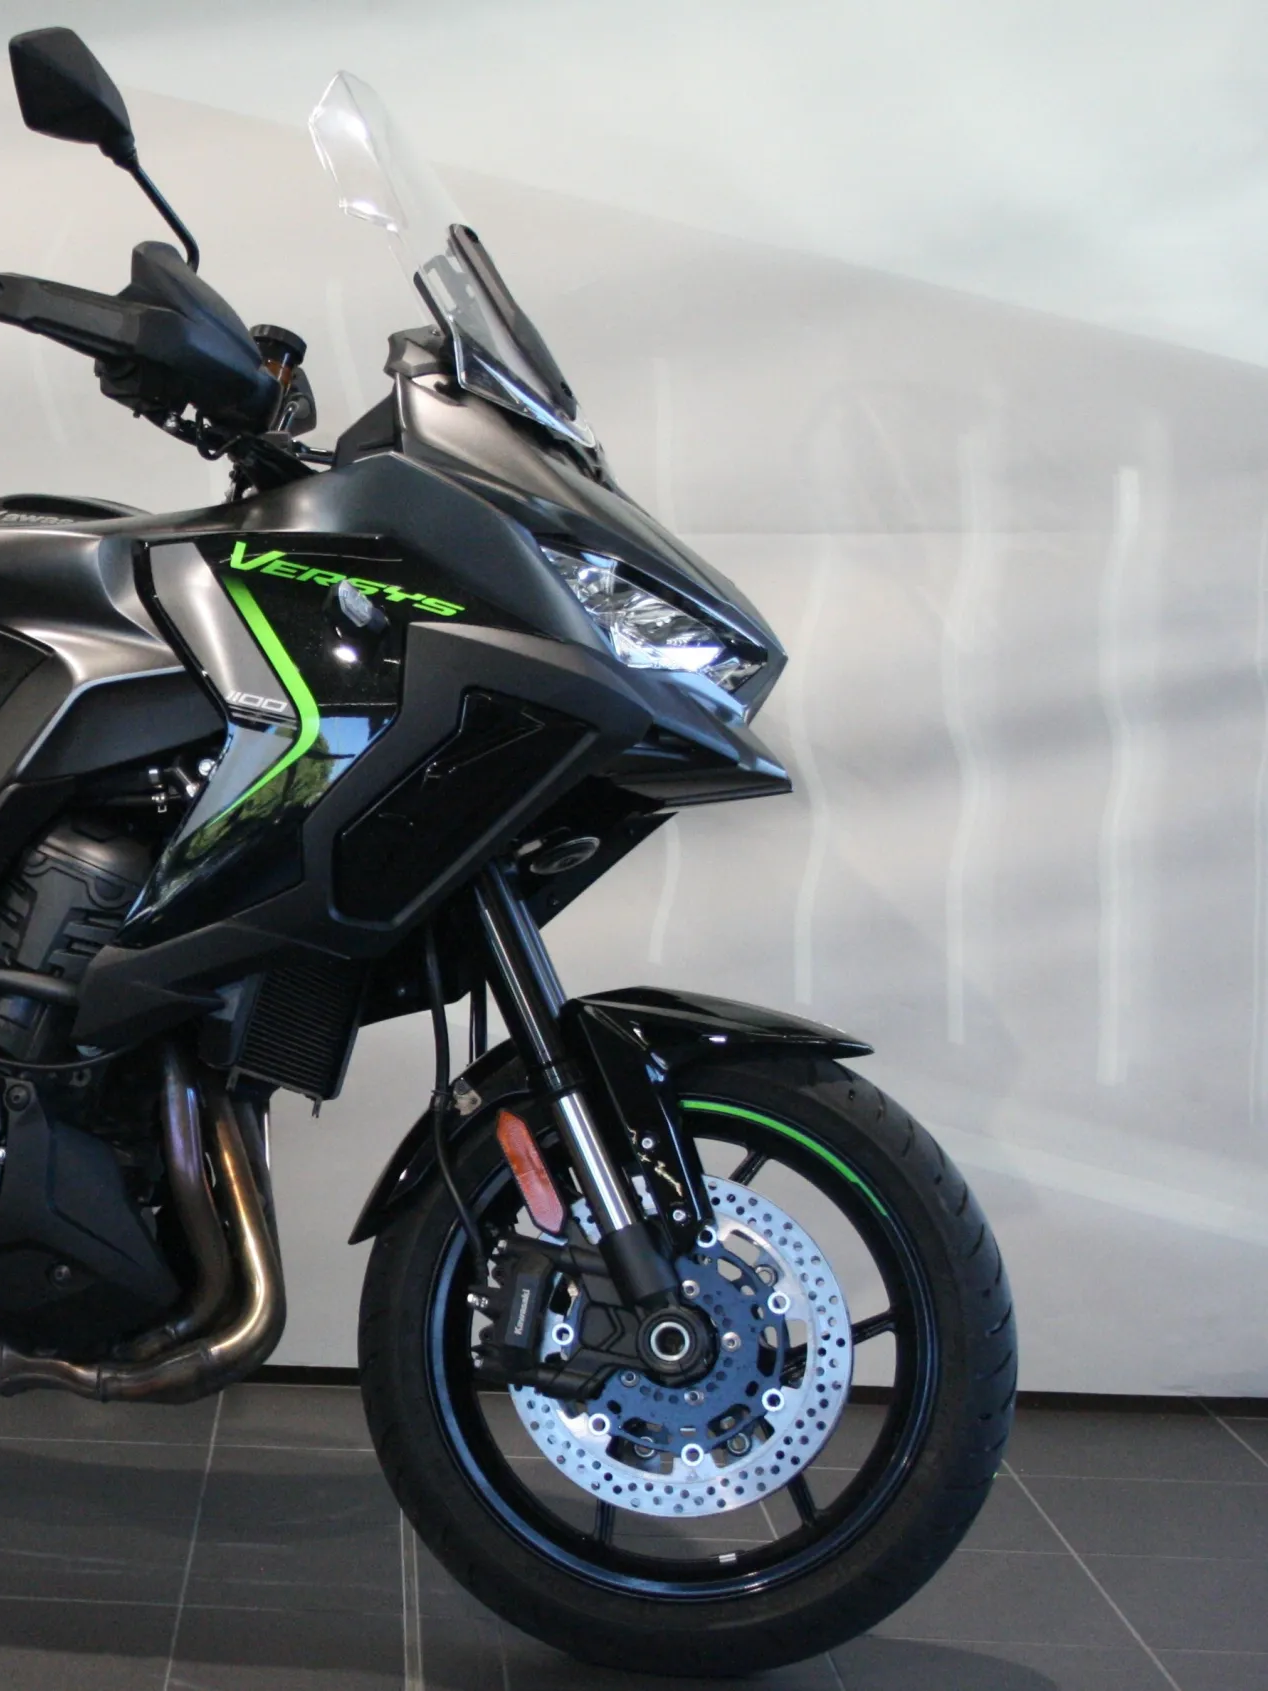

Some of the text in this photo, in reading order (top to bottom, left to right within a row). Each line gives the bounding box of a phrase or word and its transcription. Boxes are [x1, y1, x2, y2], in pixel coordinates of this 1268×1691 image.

[230, 541, 466, 617] VERSYS
[226, 690, 288, 712] 1100
[513, 1288, 531, 1336] Kawasaki
